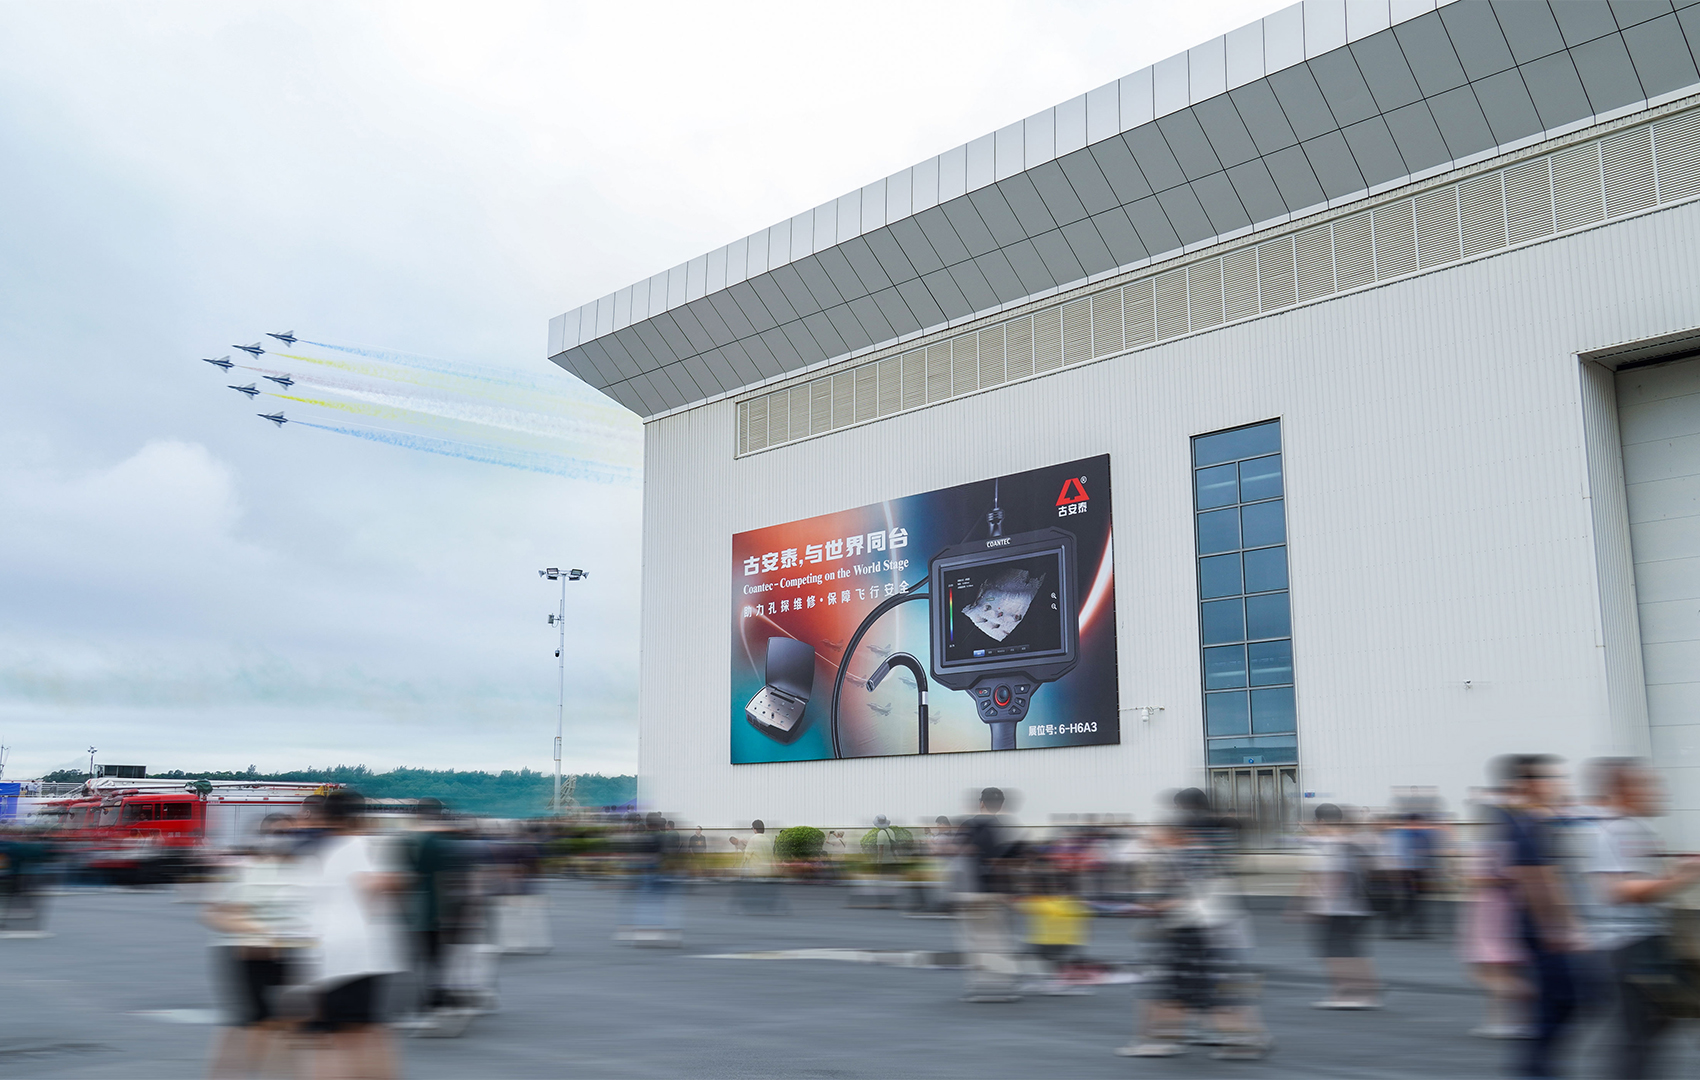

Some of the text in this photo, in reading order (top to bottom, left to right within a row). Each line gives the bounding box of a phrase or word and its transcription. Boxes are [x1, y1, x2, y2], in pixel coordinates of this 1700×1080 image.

[1058, 502, 1088, 518] 古安泰
[986, 537, 1011, 548] COANTEC
[824, 572, 835, 581] on
[837, 568, 851, 579] the
[853, 561, 881, 576] World
[883, 559, 909, 571] Stage
[1059, 722, 1098, 735] 6-H6A3
